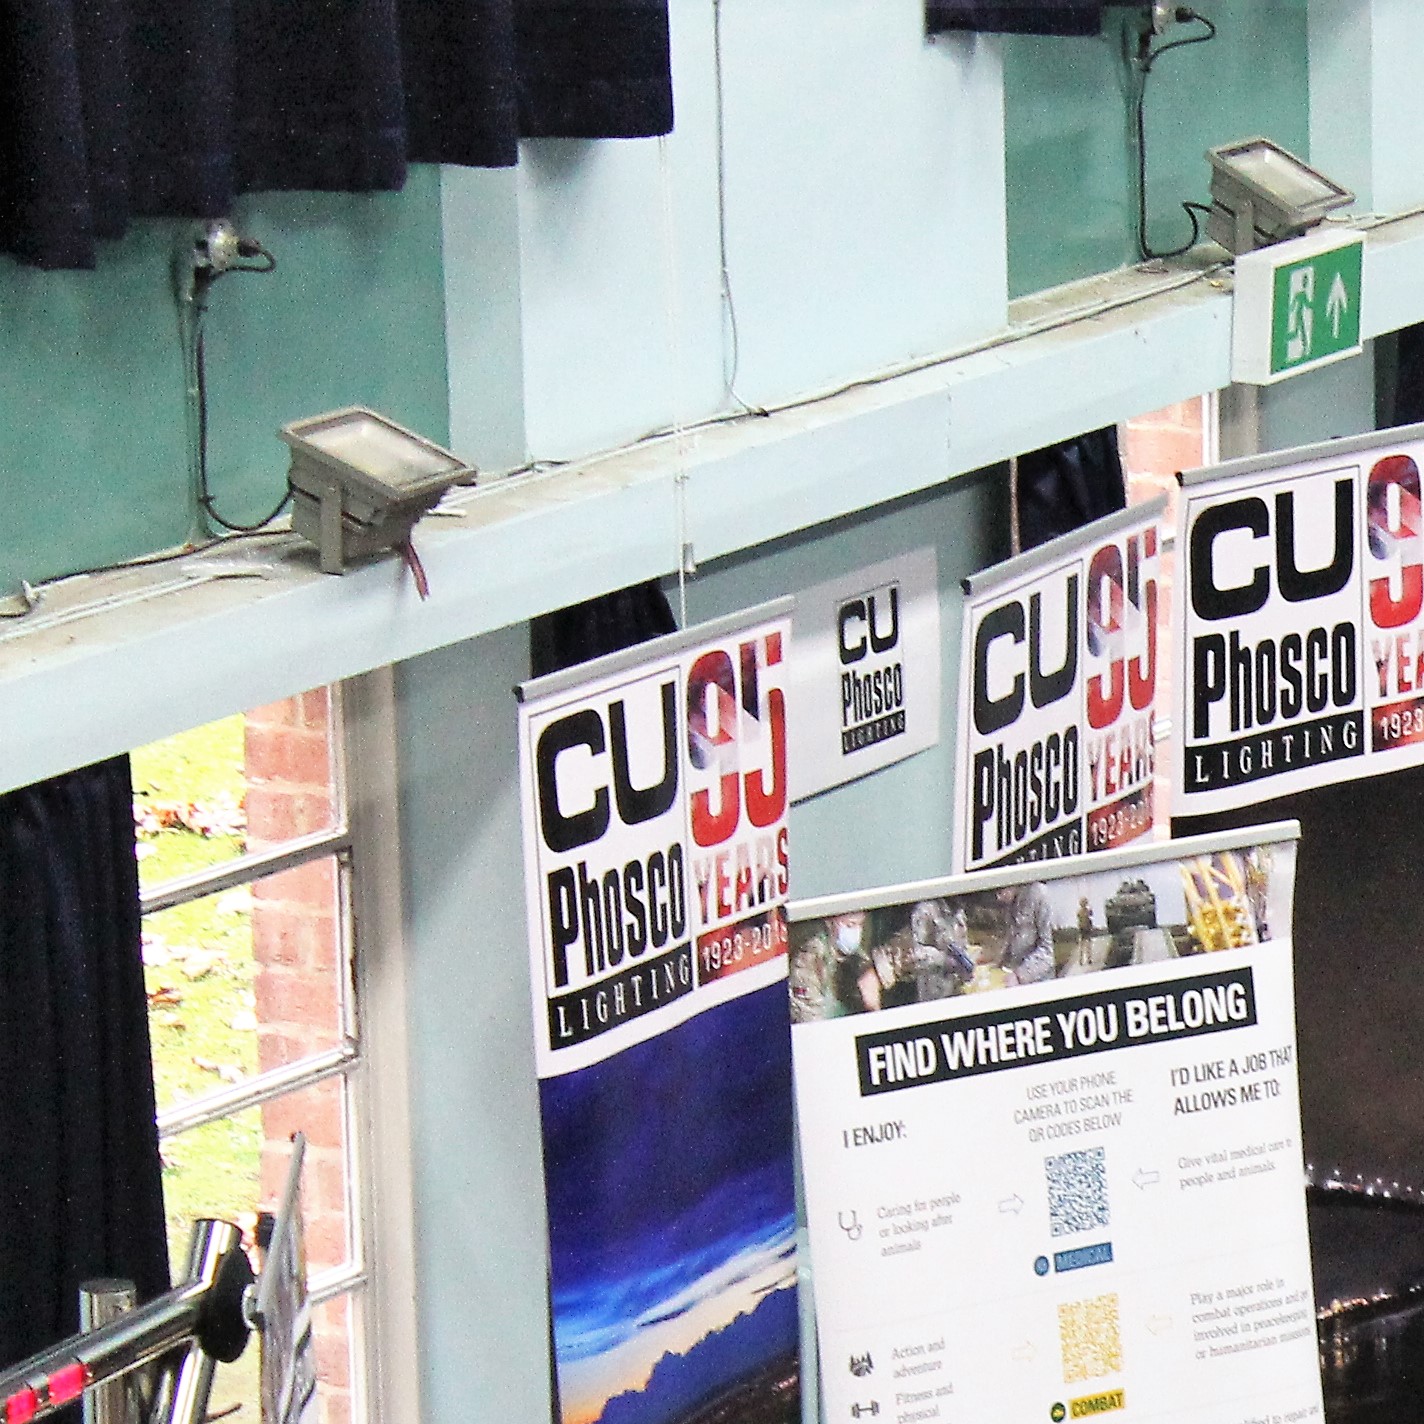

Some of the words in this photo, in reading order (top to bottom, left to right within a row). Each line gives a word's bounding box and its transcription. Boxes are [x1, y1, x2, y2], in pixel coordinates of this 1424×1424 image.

[1190, 477, 1355, 622] CU
[838, 587, 898, 665] CU
[973, 570, 1079, 736] CU
[841, 662, 902, 727] Phosco
[1192, 620, 1356, 739] Phosco
[536, 680, 678, 853] CU
[688, 633, 784, 847] 95
[1193, 721, 1357, 784] LIGHTING
[972, 725, 1078, 861] Phosco
[547, 842, 687, 987] Phosco
[692, 828, 789, 926] YEARS
[558, 962, 690, 1039] LIGHTING
[867, 1036, 938, 1086] FIND
[940, 1015, 1054, 1071] WHERE
[1056, 1003, 1119, 1050] YOU
[1124, 980, 1248, 1038] BELONG
[1193, 1059, 1224, 1082] LIKE
[1227, 1057, 1238, 1076] A
[1241, 1051, 1267, 1074] JOB
[1025, 1084, 1047, 1101] USE
[1049, 1077, 1079, 1096] YOUR
[1078, 1070, 1116, 1090] PHONE
[1172, 1087, 1236, 1116] ALLOWS
[1239, 1082, 1261, 1103] ME
[1013, 1102, 1061, 1125] CAMERA
[1063, 1098, 1078, 1114] TO
[1079, 1092, 1109, 1112] SCAN
[1110, 1088, 1134, 1106] THE
[842, 1129, 848, 1149] I
[852, 1119, 907, 1146] ENJOY:
[1046, 1119, 1082, 1139] CODES
[1083, 1111, 1122, 1132] BELOW
[1177, 1154, 1203, 1170] Give
[1204, 1148, 1227, 1165] vital
[1229, 1141, 1265, 1159] medical
[1179, 1171, 1214, 1189] people
[1215, 1166, 1235, 1181] and
[1190, 1290, 1213, 1307] Play
[1226, 1283, 1254, 1301] major
[1256, 1278, 1274, 1292] role
[1191, 1305, 1231, 1323] combat
[890, 1343, 925, 1360] Action
[927, 1337, 945, 1352] and
[1193, 1322, 1238, 1342] involved
[934, 1381, 953, 1397] and
[1072, 1391, 1124, 1416] COMBAT
